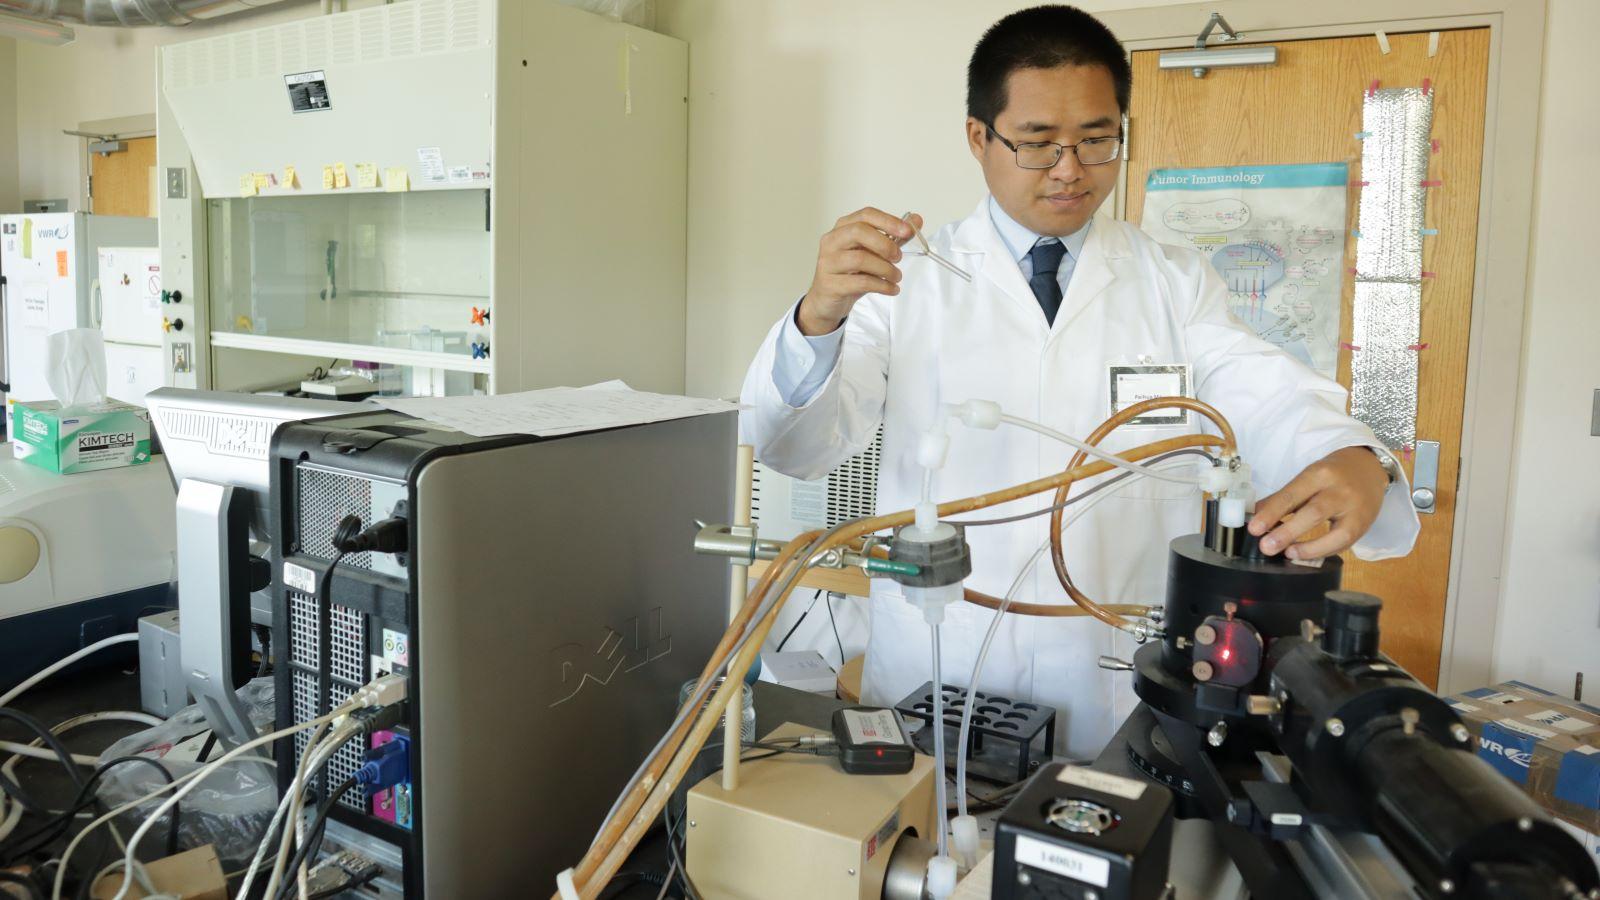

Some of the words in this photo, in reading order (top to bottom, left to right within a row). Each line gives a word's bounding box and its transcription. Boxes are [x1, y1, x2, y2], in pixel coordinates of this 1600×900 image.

[1153, 174, 1188, 186] Tumor
[1191, 171, 1265, 184] Immunology
[37, 229, 54, 238] VWR
[79, 432, 134, 447] KIMTECH
[548, 605, 672, 708] DELL
